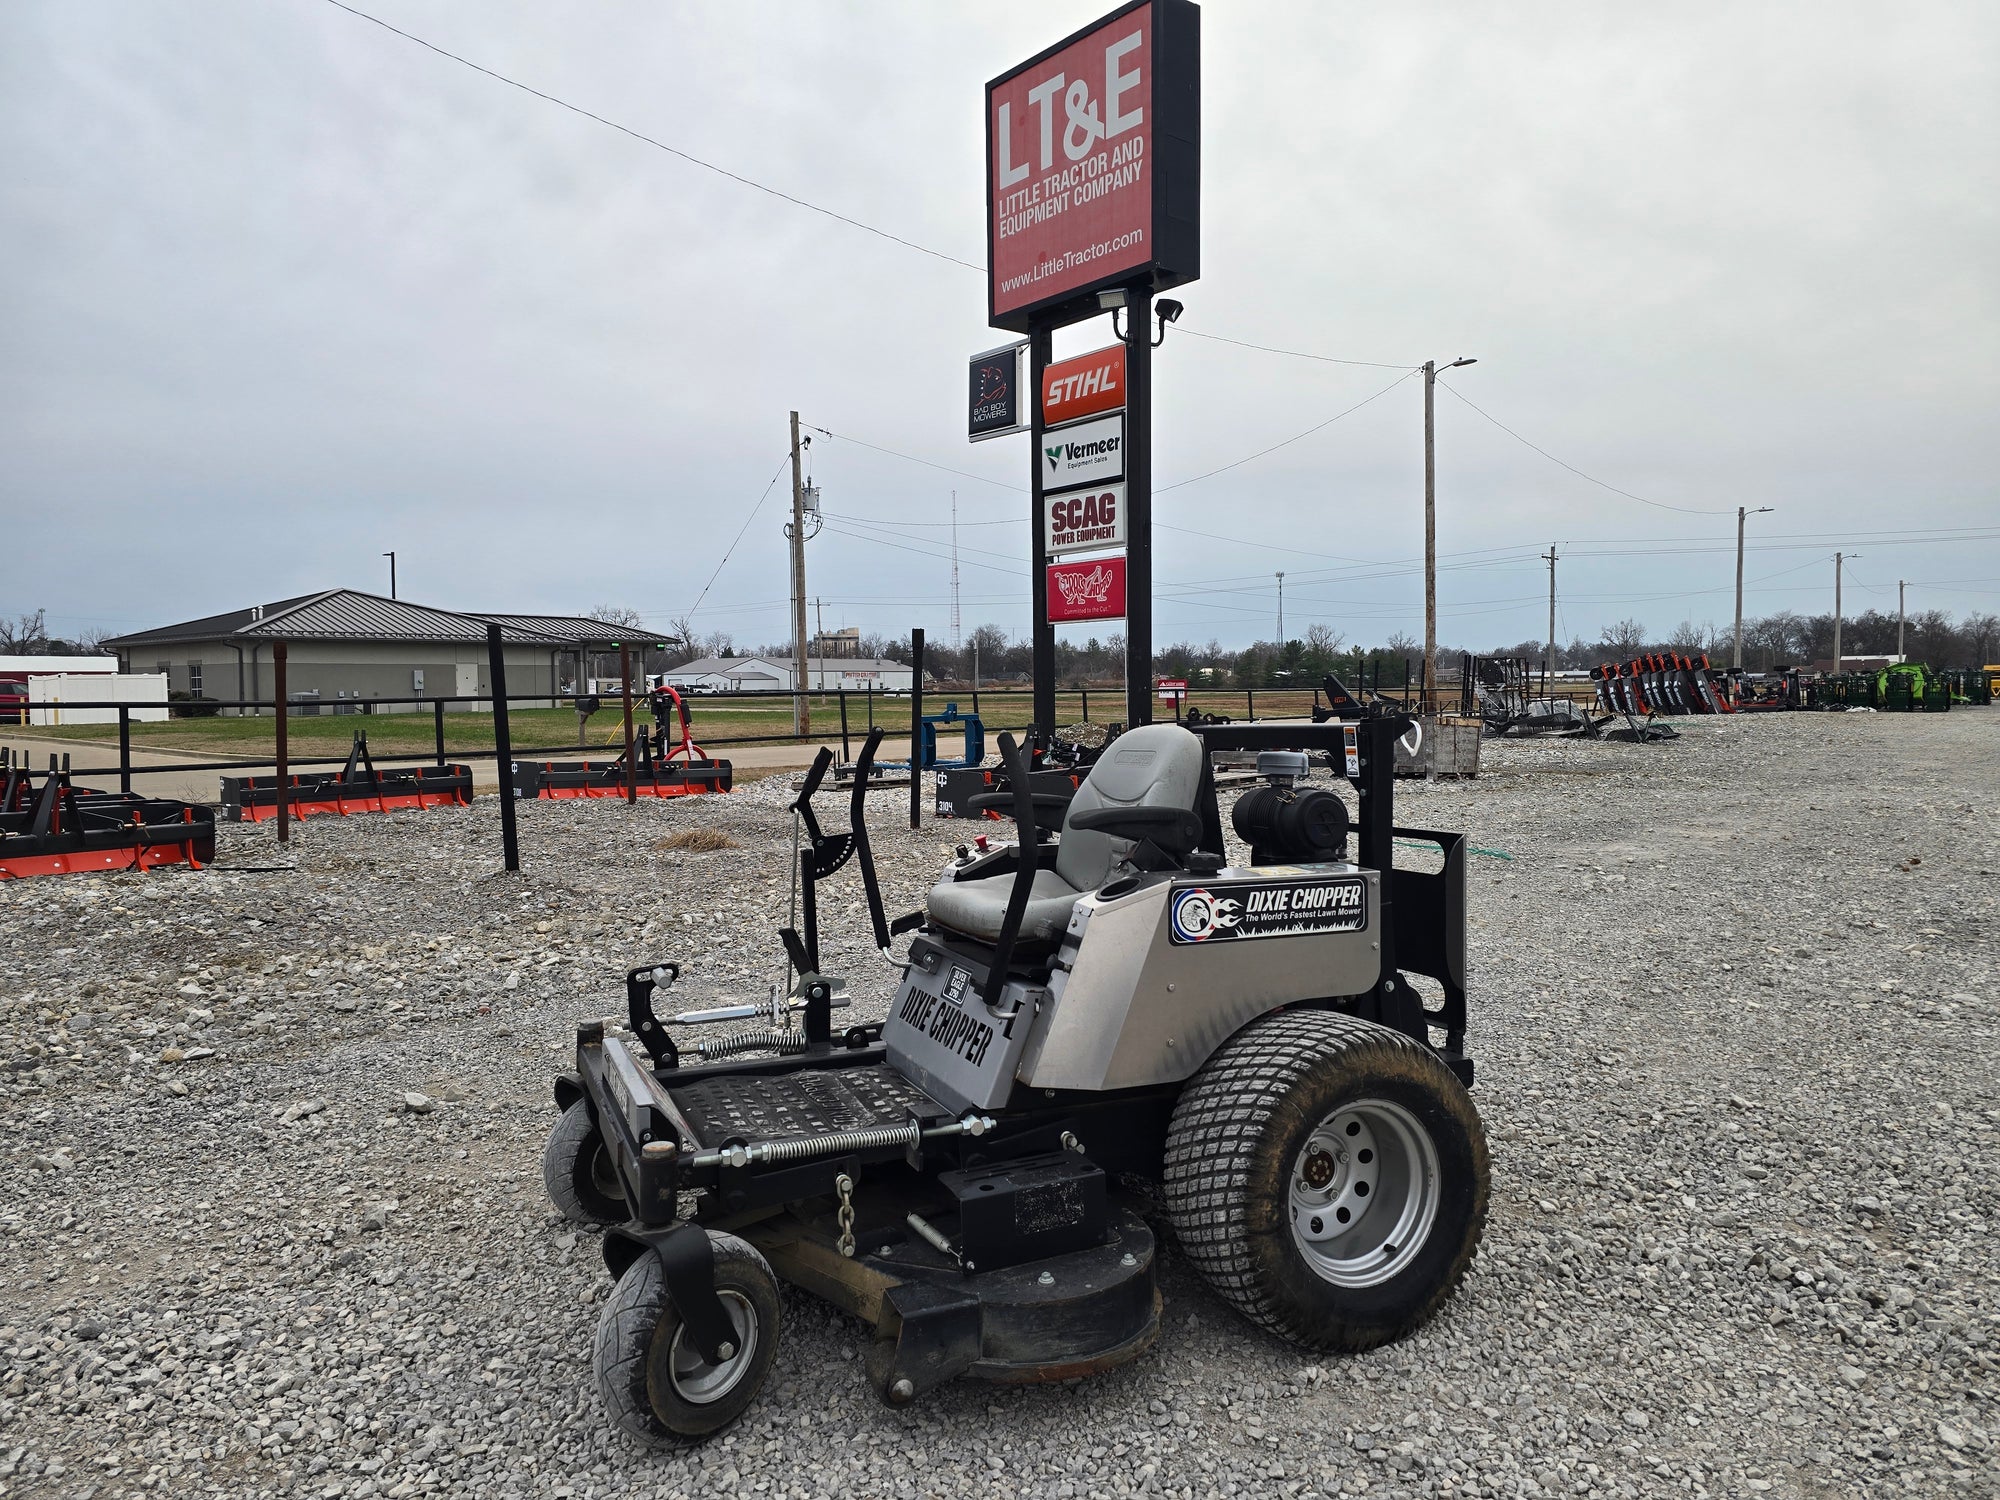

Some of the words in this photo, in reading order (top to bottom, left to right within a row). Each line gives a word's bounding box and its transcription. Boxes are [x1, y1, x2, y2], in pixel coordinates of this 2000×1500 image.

[999, 29, 1143, 190] LT&E
[999, 182, 1040, 219] LITTLE
[1043, 152, 1107, 195] TRACTOR
[1112, 136, 1143, 166] AND
[999, 194, 1069, 239] EQUIPMENT
[1074, 159, 1143, 209] COMPANY
[1001, 227, 1143, 293] www.LittleTractor.com
[1046, 365, 1116, 407] STIHL
[973, 405, 989, 416] BAD
[990, 401, 1007, 411] BOY
[973, 408, 1007, 423] MOWERS
[1065, 436, 1120, 461] Vermeer
[1067, 458, 1093, 470] Equipment
[1094, 455, 1108, 465] Sales
[1051, 492, 1116, 533] SCAG
[1052, 531, 1075, 547] POWER
[1076, 525, 1116, 543] EQUIPMENT
[1063, 606, 1087, 616] Committed
[1091, 605, 1100, 613] the
[938, 800, 953, 812] 3104
[1246, 890, 1290, 912] DIXIE
[1291, 885, 1361, 909] CHOPPER
[1245, 913, 1259, 923] The
[1260, 911, 1289, 922] World's
[1289, 909, 1317, 920] Fastest
[1317, 908, 1337, 918] Lawn
[1337, 907, 1362, 917] Mower
[950, 977, 965, 991] EAGLE
[899, 986, 937, 1032] DIXIE
[929, 1002, 994, 1068] CHOPPER
